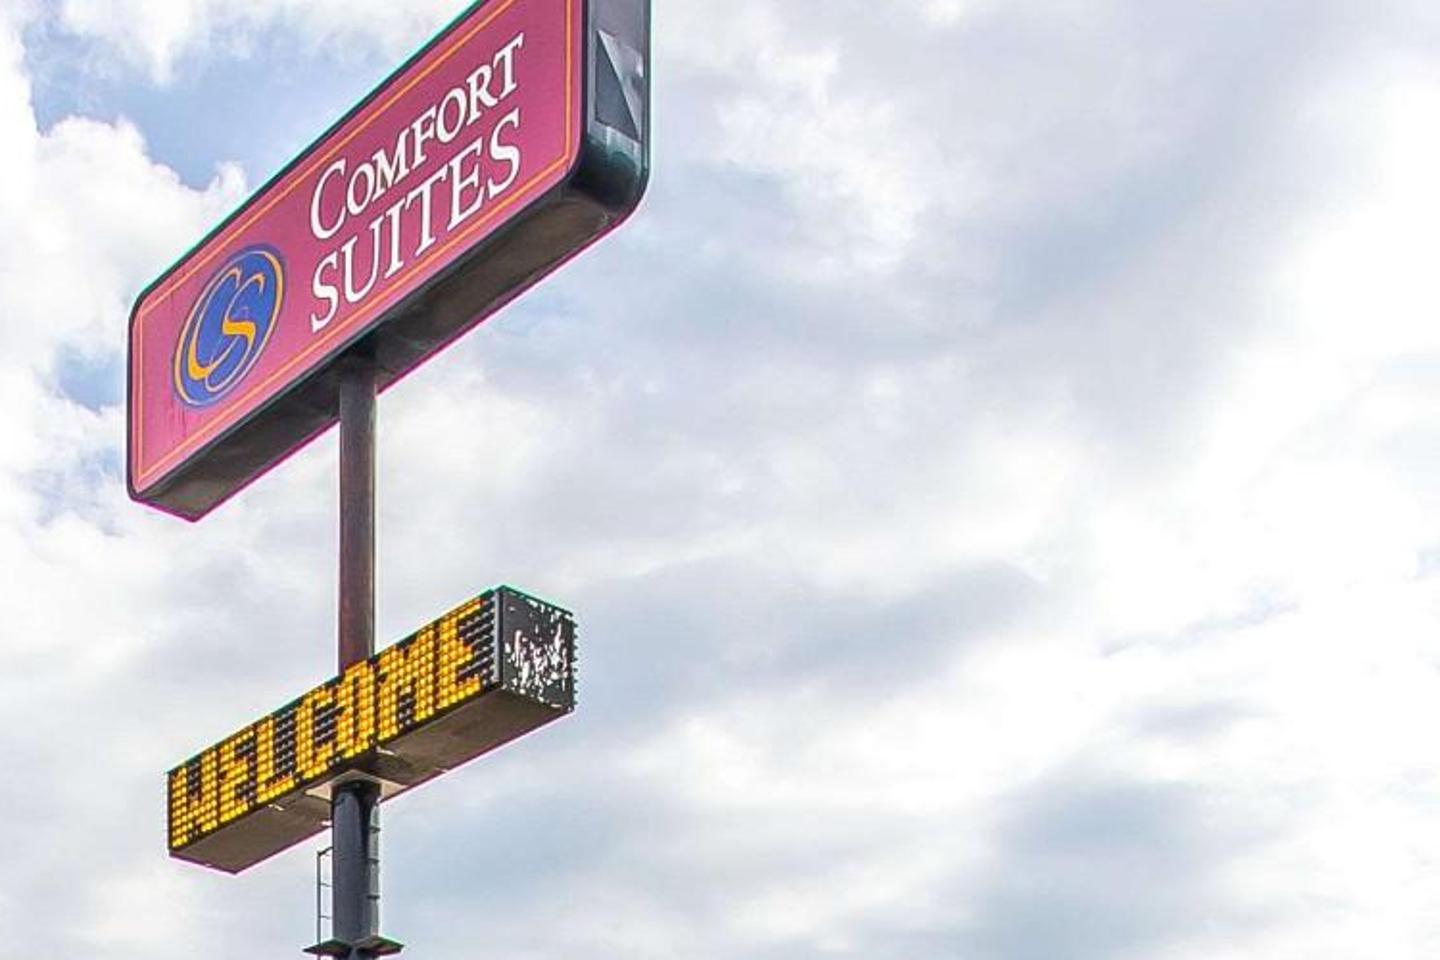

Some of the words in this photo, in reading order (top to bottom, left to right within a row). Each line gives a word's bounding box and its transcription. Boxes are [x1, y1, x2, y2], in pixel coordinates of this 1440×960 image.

[309, 33, 524, 239] COMFORT
[310, 107, 521, 333] SUITES
[171, 599, 485, 848] WELCOME
